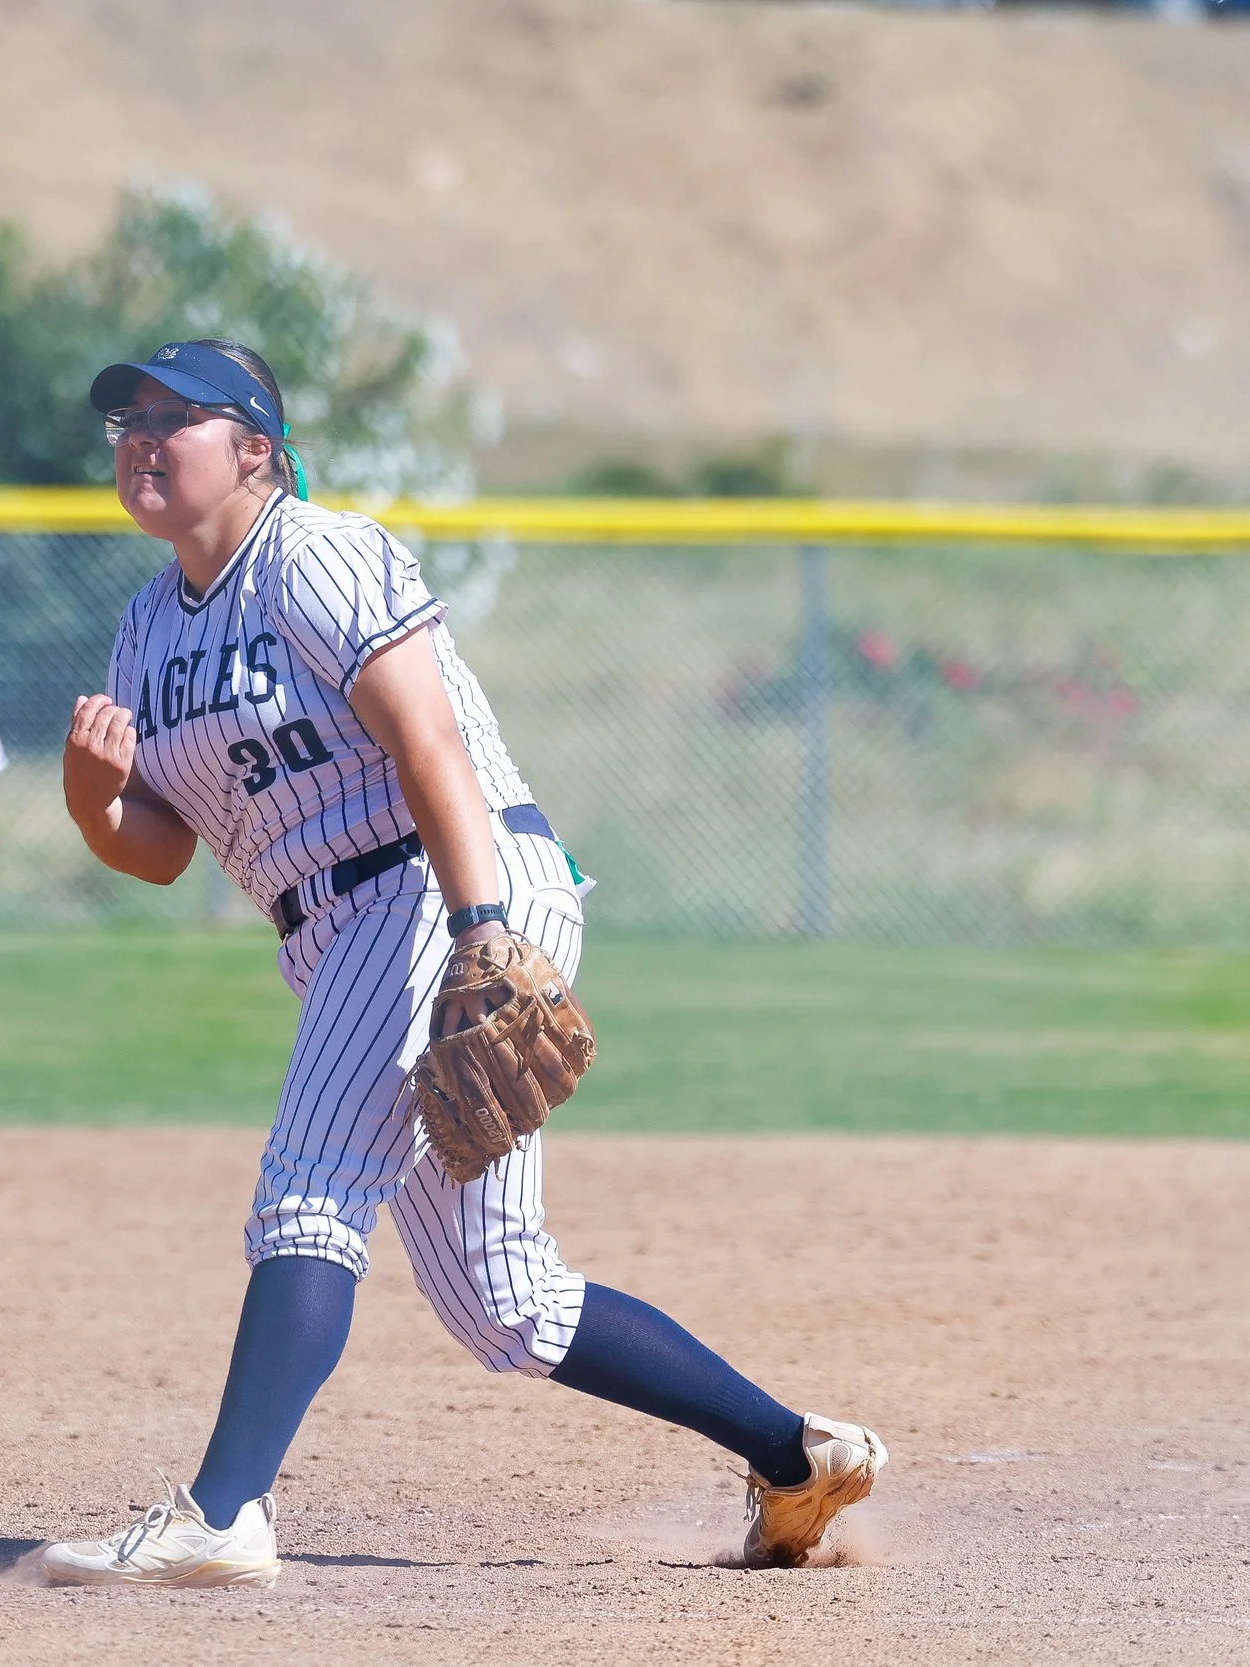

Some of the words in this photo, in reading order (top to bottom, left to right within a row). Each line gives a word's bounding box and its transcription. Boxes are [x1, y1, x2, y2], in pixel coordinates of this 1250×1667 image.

[135, 632, 277, 745] AGLES
[227, 718, 333, 797] 30
[475, 1107, 507, 1145] A2000
